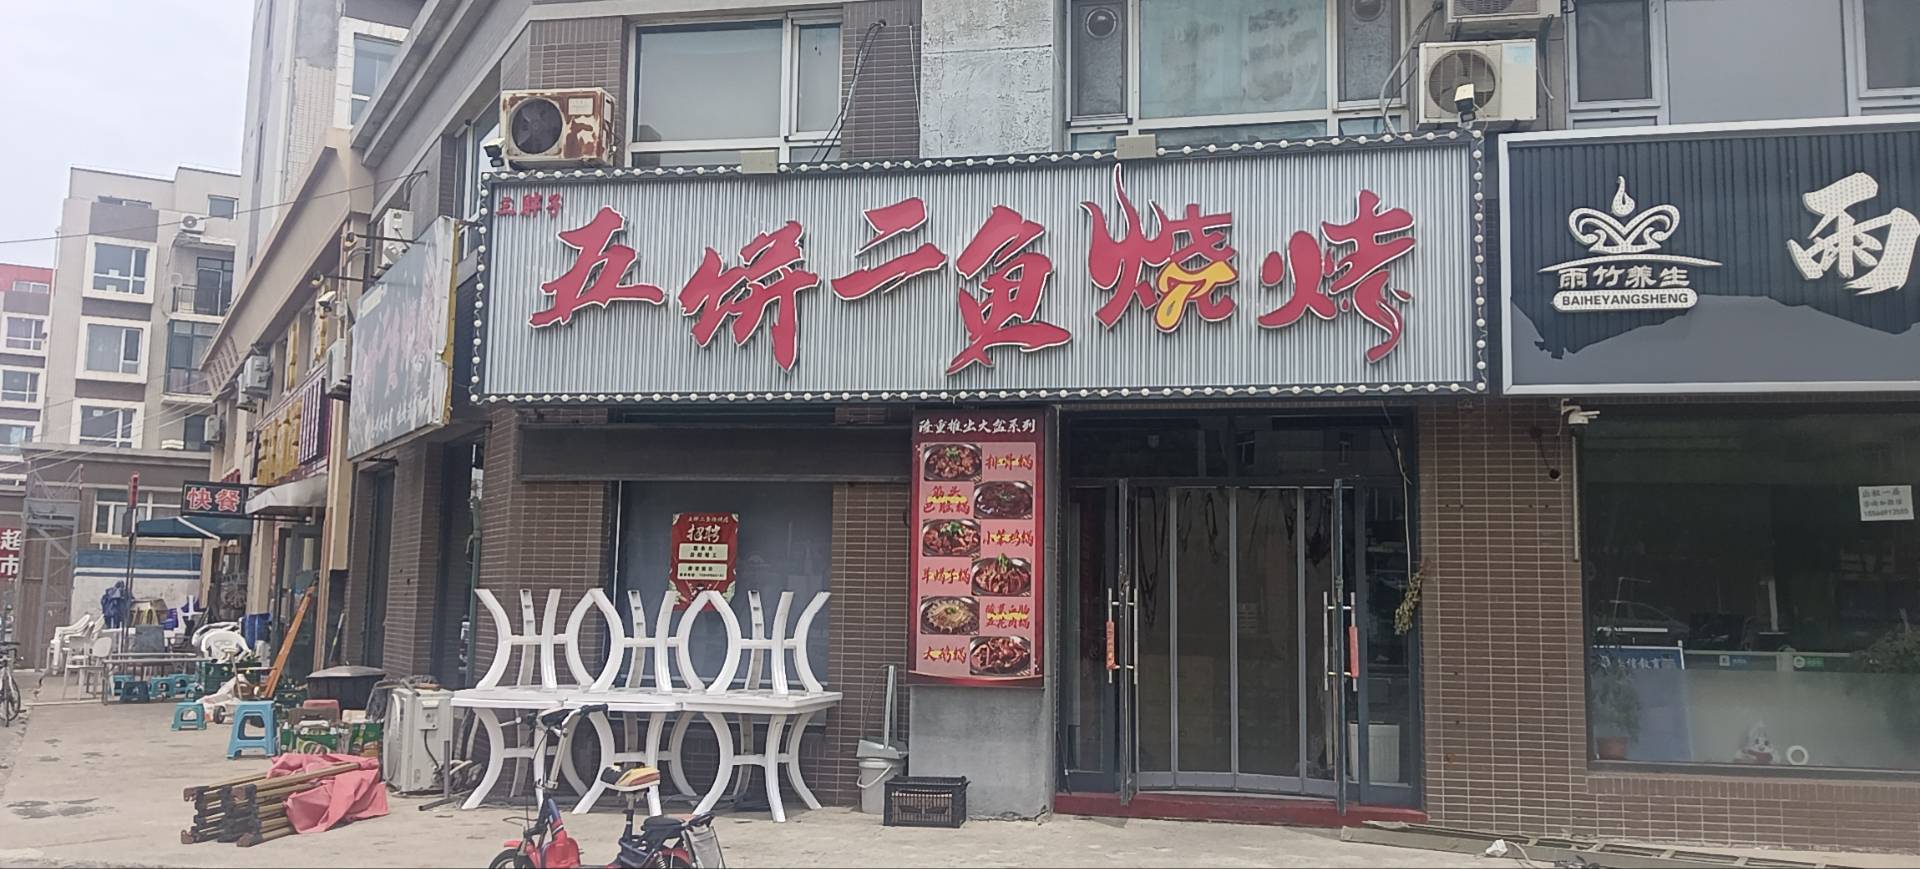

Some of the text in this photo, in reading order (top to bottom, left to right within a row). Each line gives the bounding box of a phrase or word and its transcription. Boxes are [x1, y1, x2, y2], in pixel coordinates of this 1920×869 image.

[1786, 171, 1920, 296] 雨
[528, 163, 1416, 375] 五饼二鱼烧烤
[1558, 266, 1691, 290] 雨竹养生
[1561, 292, 1689, 307] BAIHEYANGSHENG
[918, 418, 1036, 434] 隆重推出大盆系列
[186, 487, 241, 513] 快餐
[686, 524, 721, 543] 招聘
[0, 528, 22, 576] 超市
